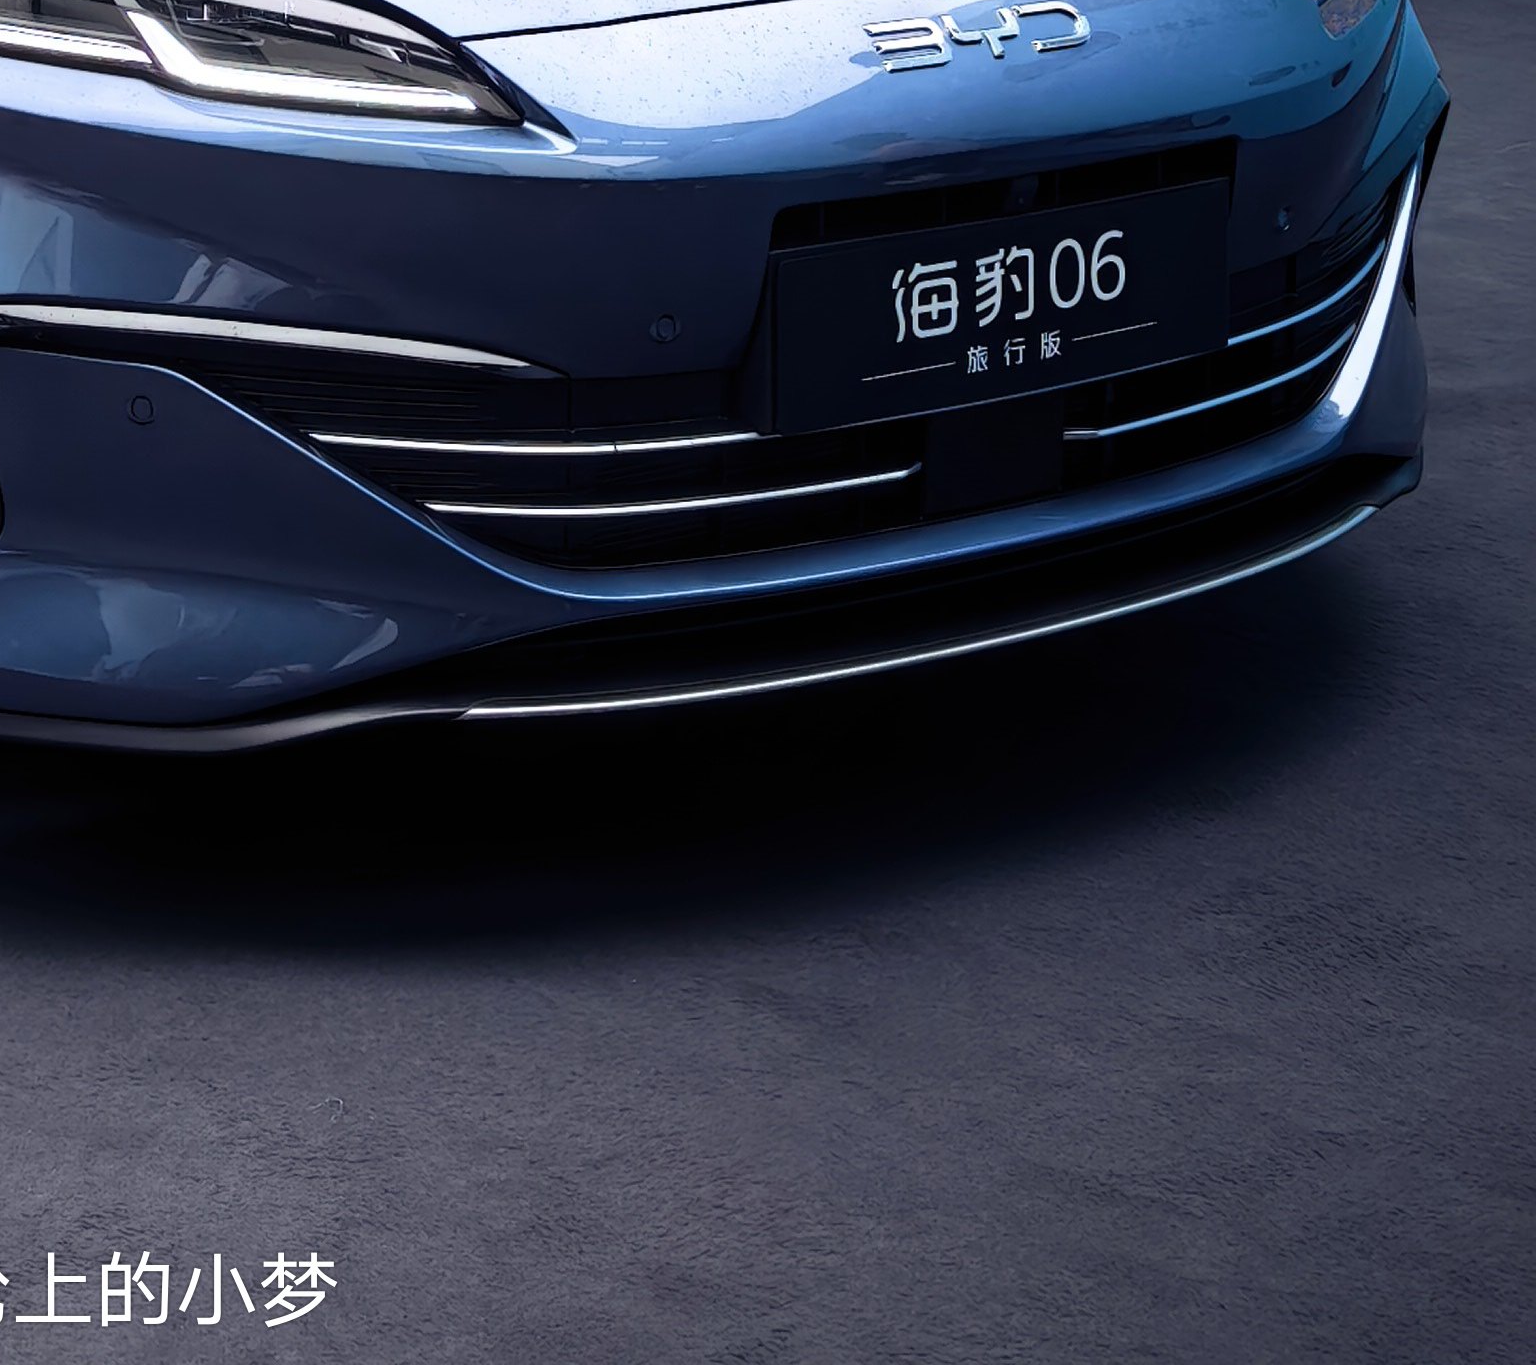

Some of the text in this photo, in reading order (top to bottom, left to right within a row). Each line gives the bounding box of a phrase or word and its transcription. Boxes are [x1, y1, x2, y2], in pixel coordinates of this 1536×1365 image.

[863, 0, 1092, 72] BYD
[891, 230, 1128, 344] 海豹06
[966, 331, 1063, 374] 旅行版
